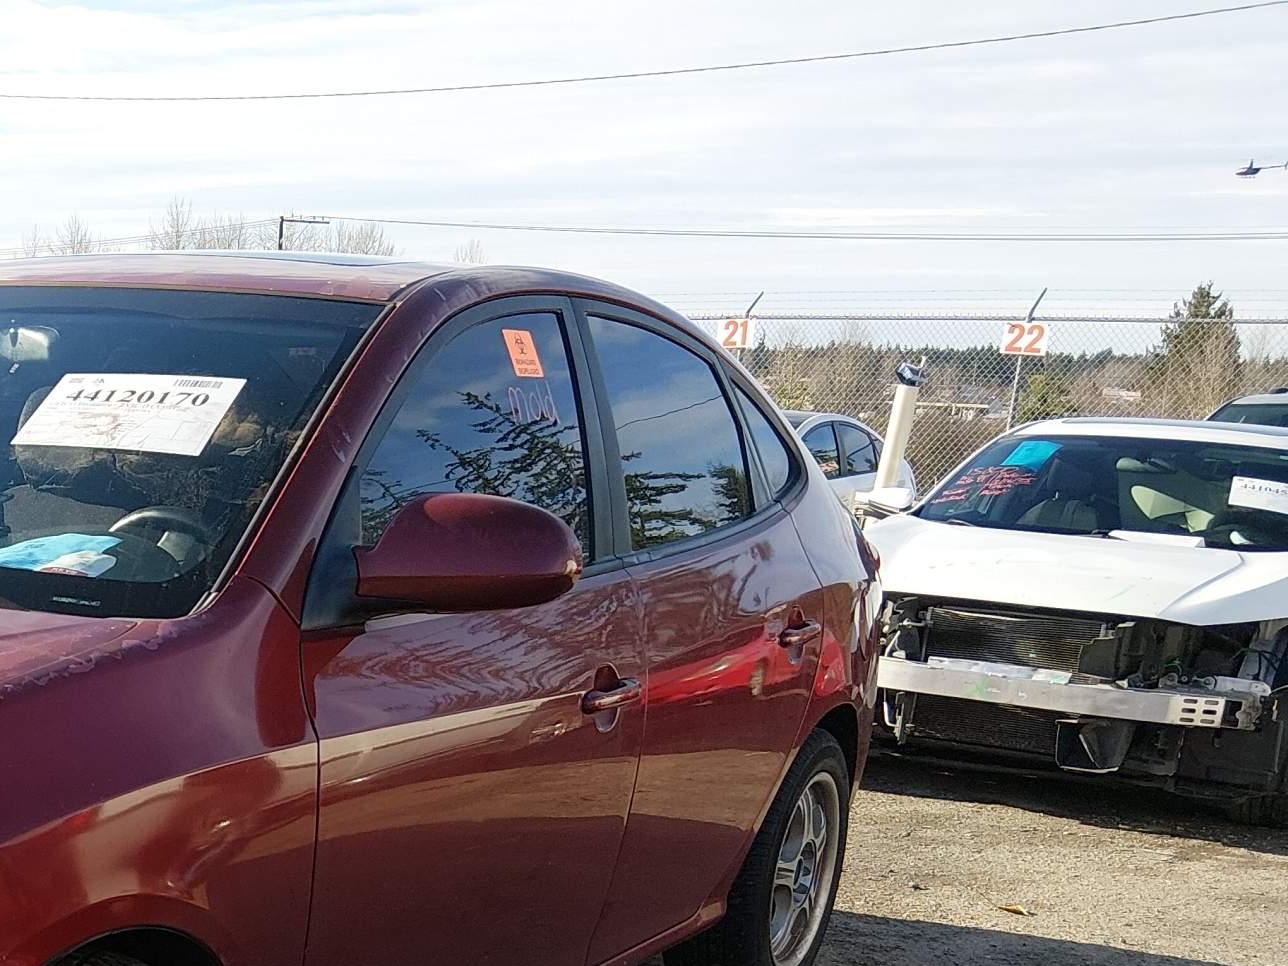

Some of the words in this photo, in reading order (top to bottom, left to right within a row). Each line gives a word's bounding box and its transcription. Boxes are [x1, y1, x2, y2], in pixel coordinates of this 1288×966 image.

[724, 320, 749, 347] 21
[1006, 323, 1045, 353] 22
[65, 388, 211, 407] 44120170
